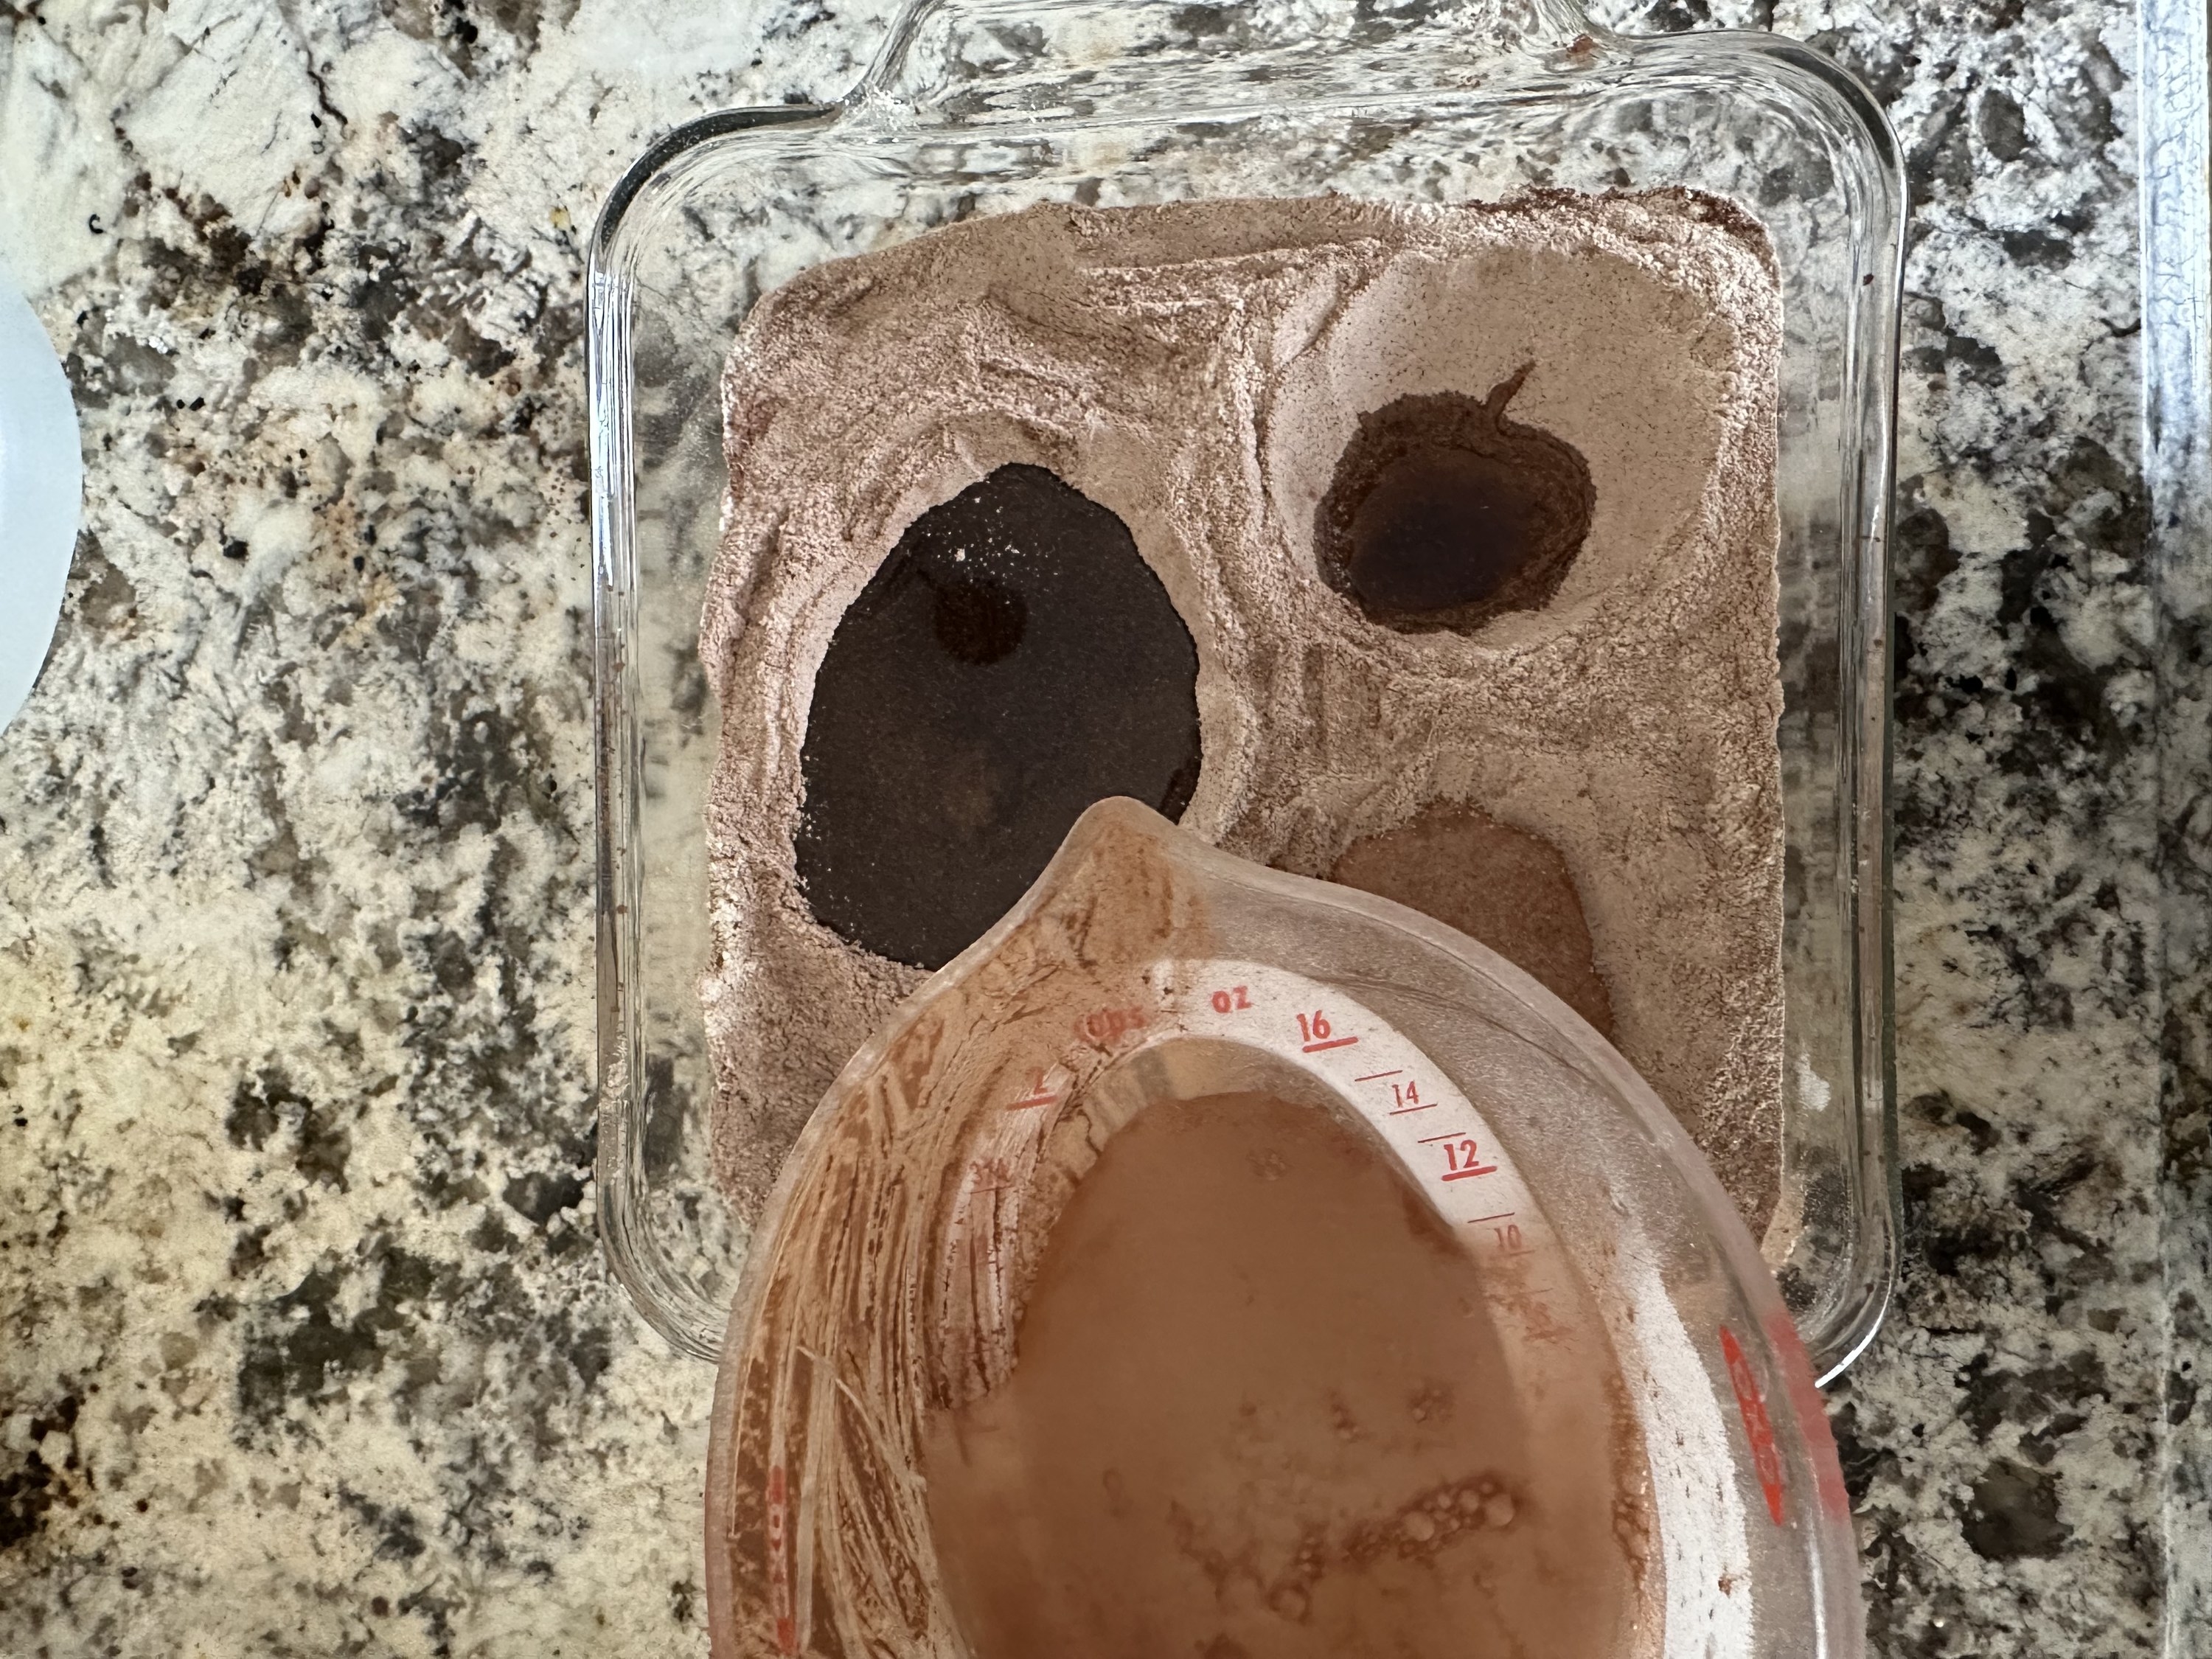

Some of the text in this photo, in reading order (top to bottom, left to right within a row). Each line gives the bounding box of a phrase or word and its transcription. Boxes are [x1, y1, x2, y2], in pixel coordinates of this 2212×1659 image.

[1296, 1009, 1332, 1042] 16
[1392, 1081, 1419, 1108] 14
[1443, 1140, 1480, 1171] 12
[1494, 1224, 1522, 1251] 10
